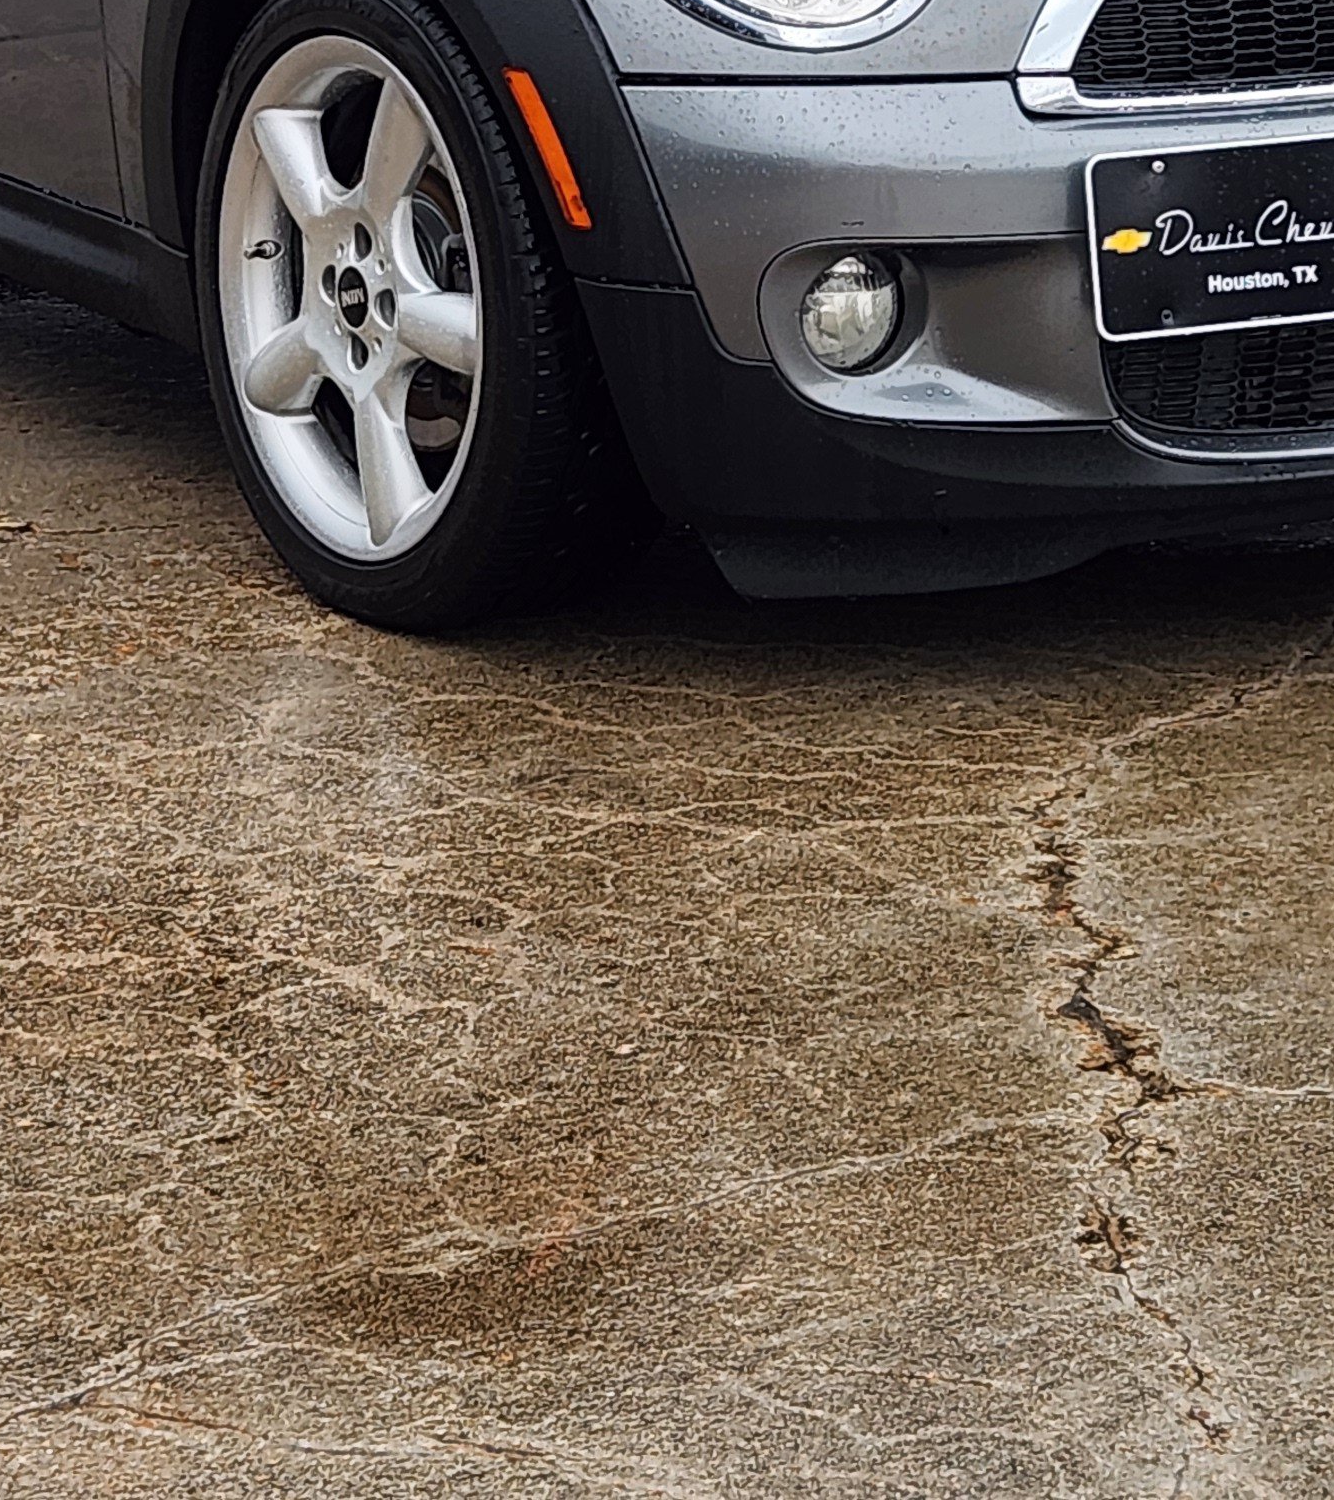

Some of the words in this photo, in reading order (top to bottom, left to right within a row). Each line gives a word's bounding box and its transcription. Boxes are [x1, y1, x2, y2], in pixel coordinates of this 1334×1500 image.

[1155, 209, 1254, 255] Davis
[1208, 271, 1290, 293] Houston,
[1291, 265, 1318, 283] TX
